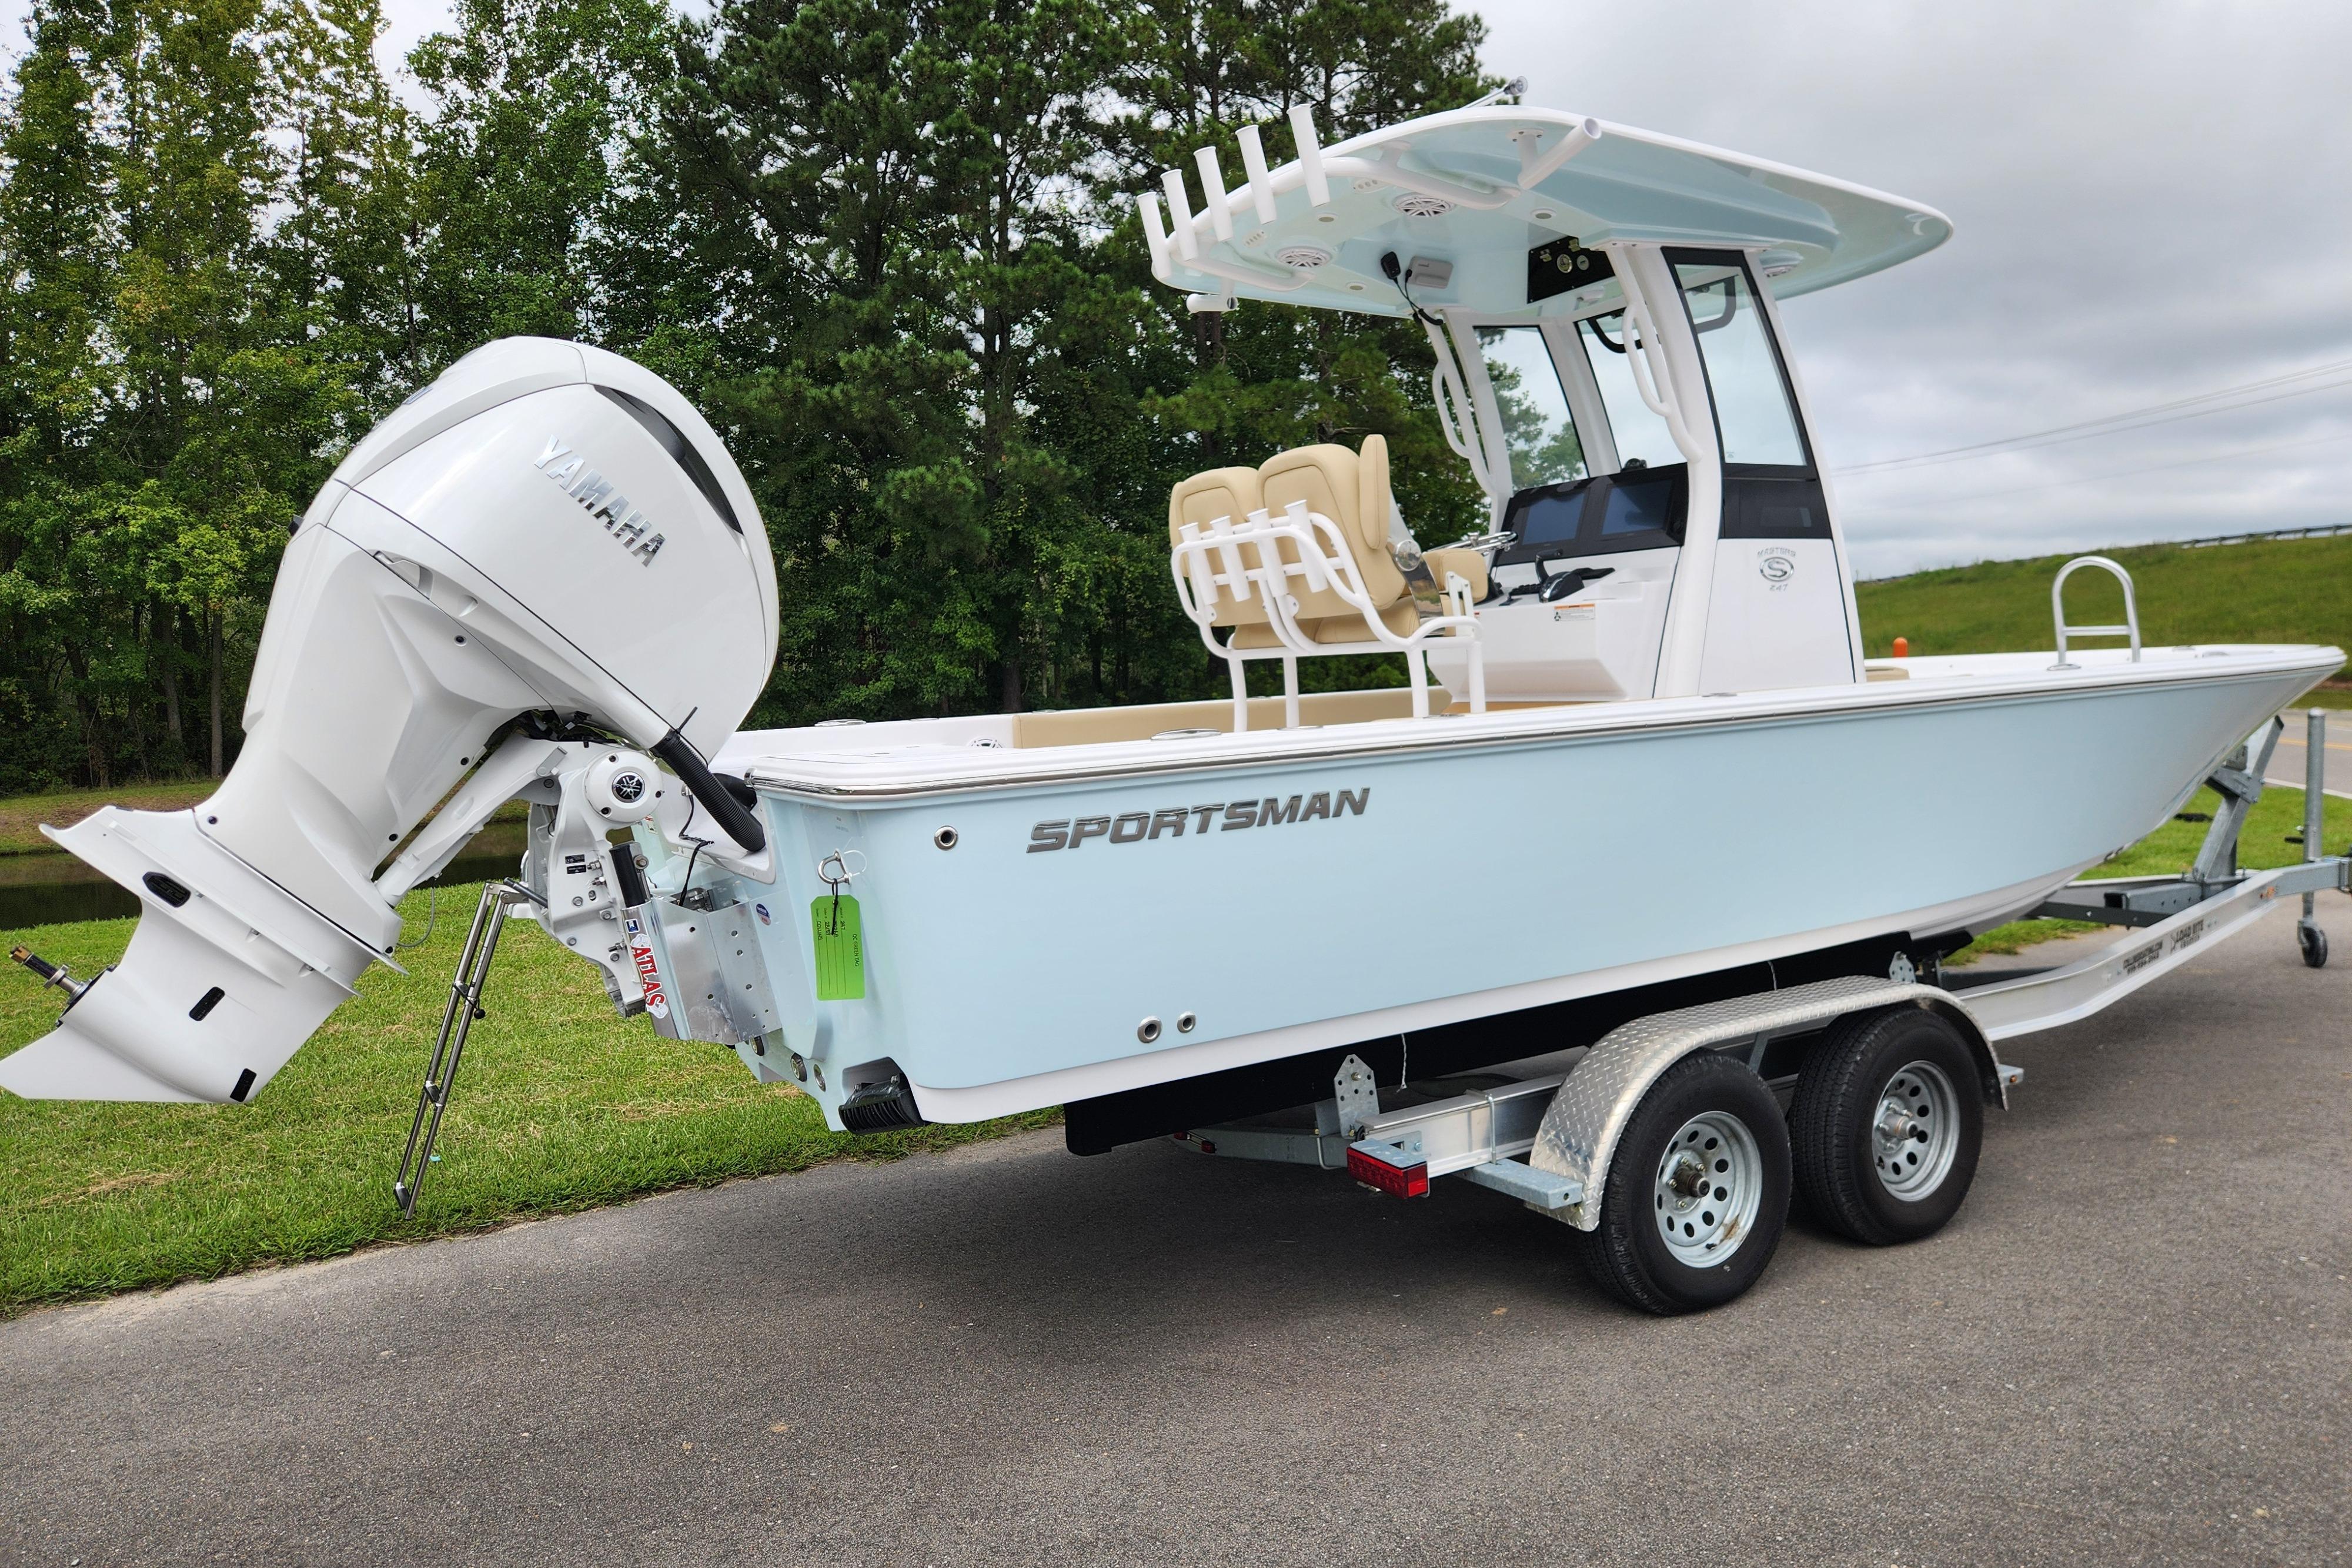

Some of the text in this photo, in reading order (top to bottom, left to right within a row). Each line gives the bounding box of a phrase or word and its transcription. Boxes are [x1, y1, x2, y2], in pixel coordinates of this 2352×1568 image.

[533, 433, 666, 568] YAMAHA
[1757, 547, 1796, 557] MASTERS
[1026, 787, 1371, 854] SPORTSMAN
[630, 946, 666, 1008] ATLAS
